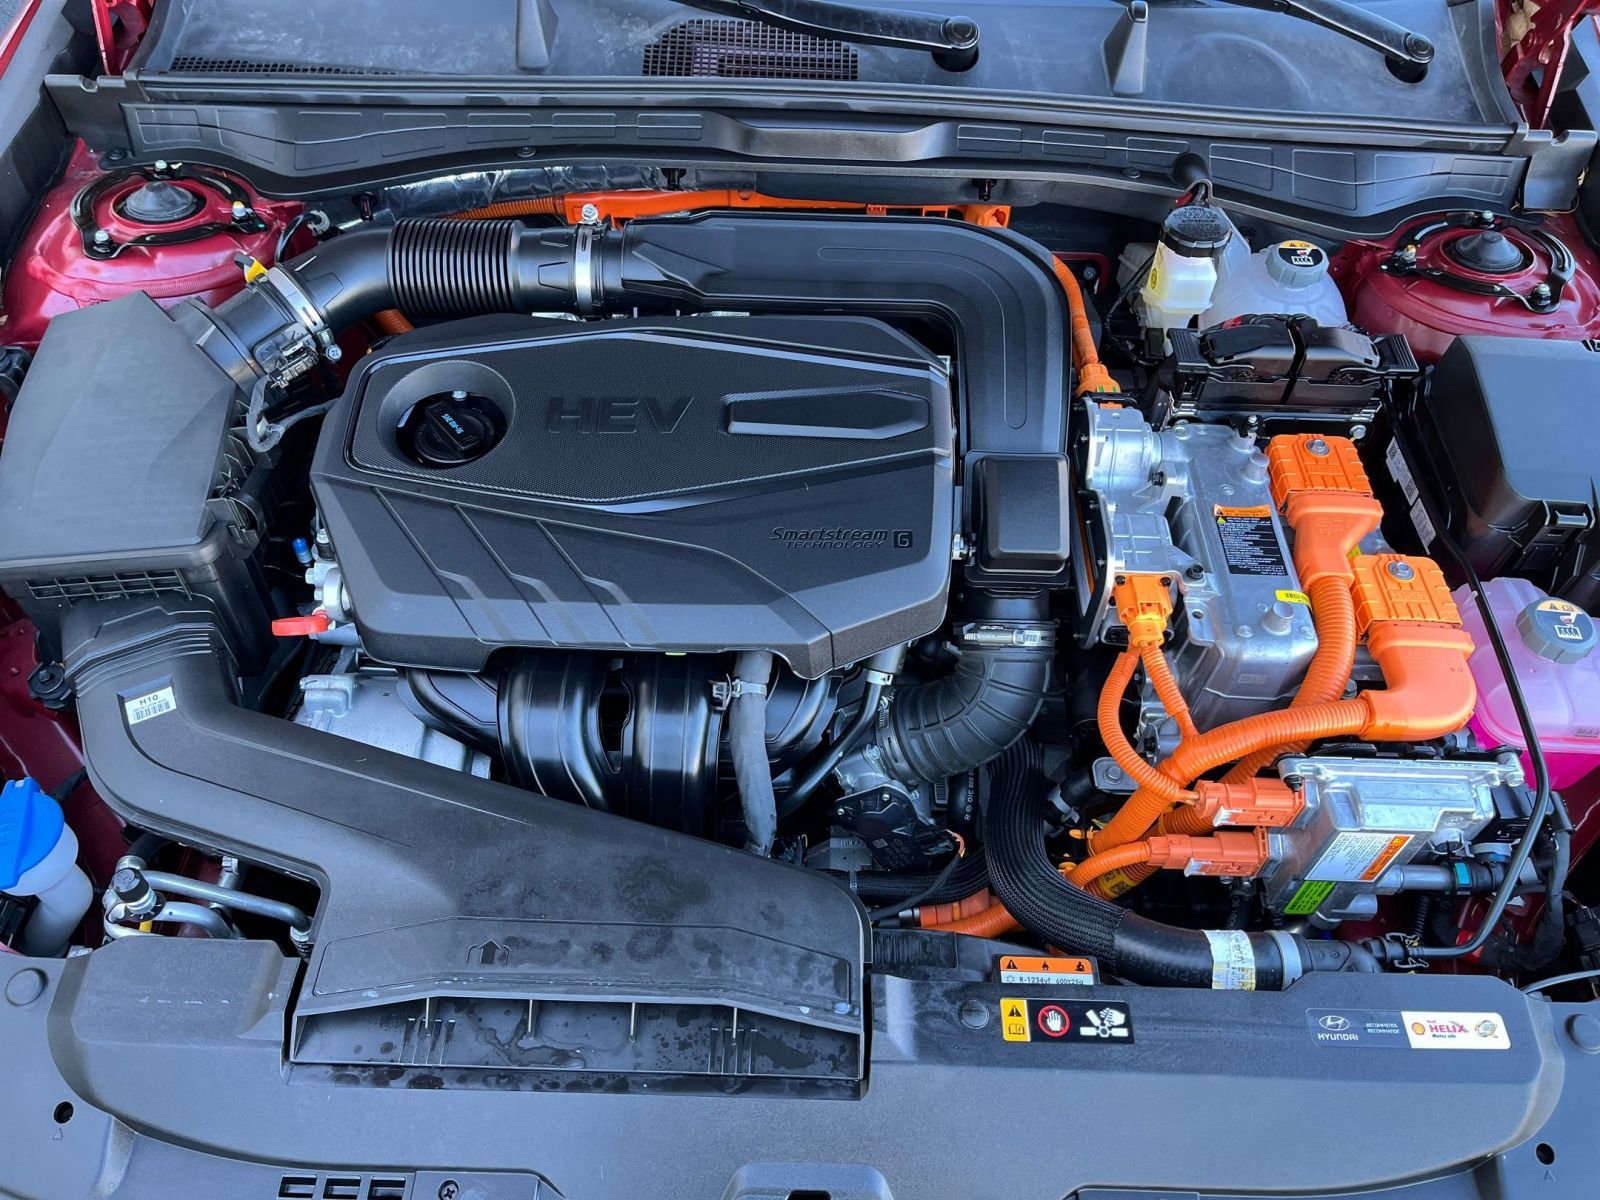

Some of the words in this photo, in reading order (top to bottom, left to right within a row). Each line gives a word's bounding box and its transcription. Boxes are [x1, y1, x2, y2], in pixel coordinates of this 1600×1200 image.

[548, 396, 694, 434] HEV
[769, 526, 888, 541] Smartstream
[785, 540, 885, 549] TECHNOLOGY
[1428, 1024, 1468, 1033] HELIX
[1317, 1032, 1359, 1041] HYUNDAI
